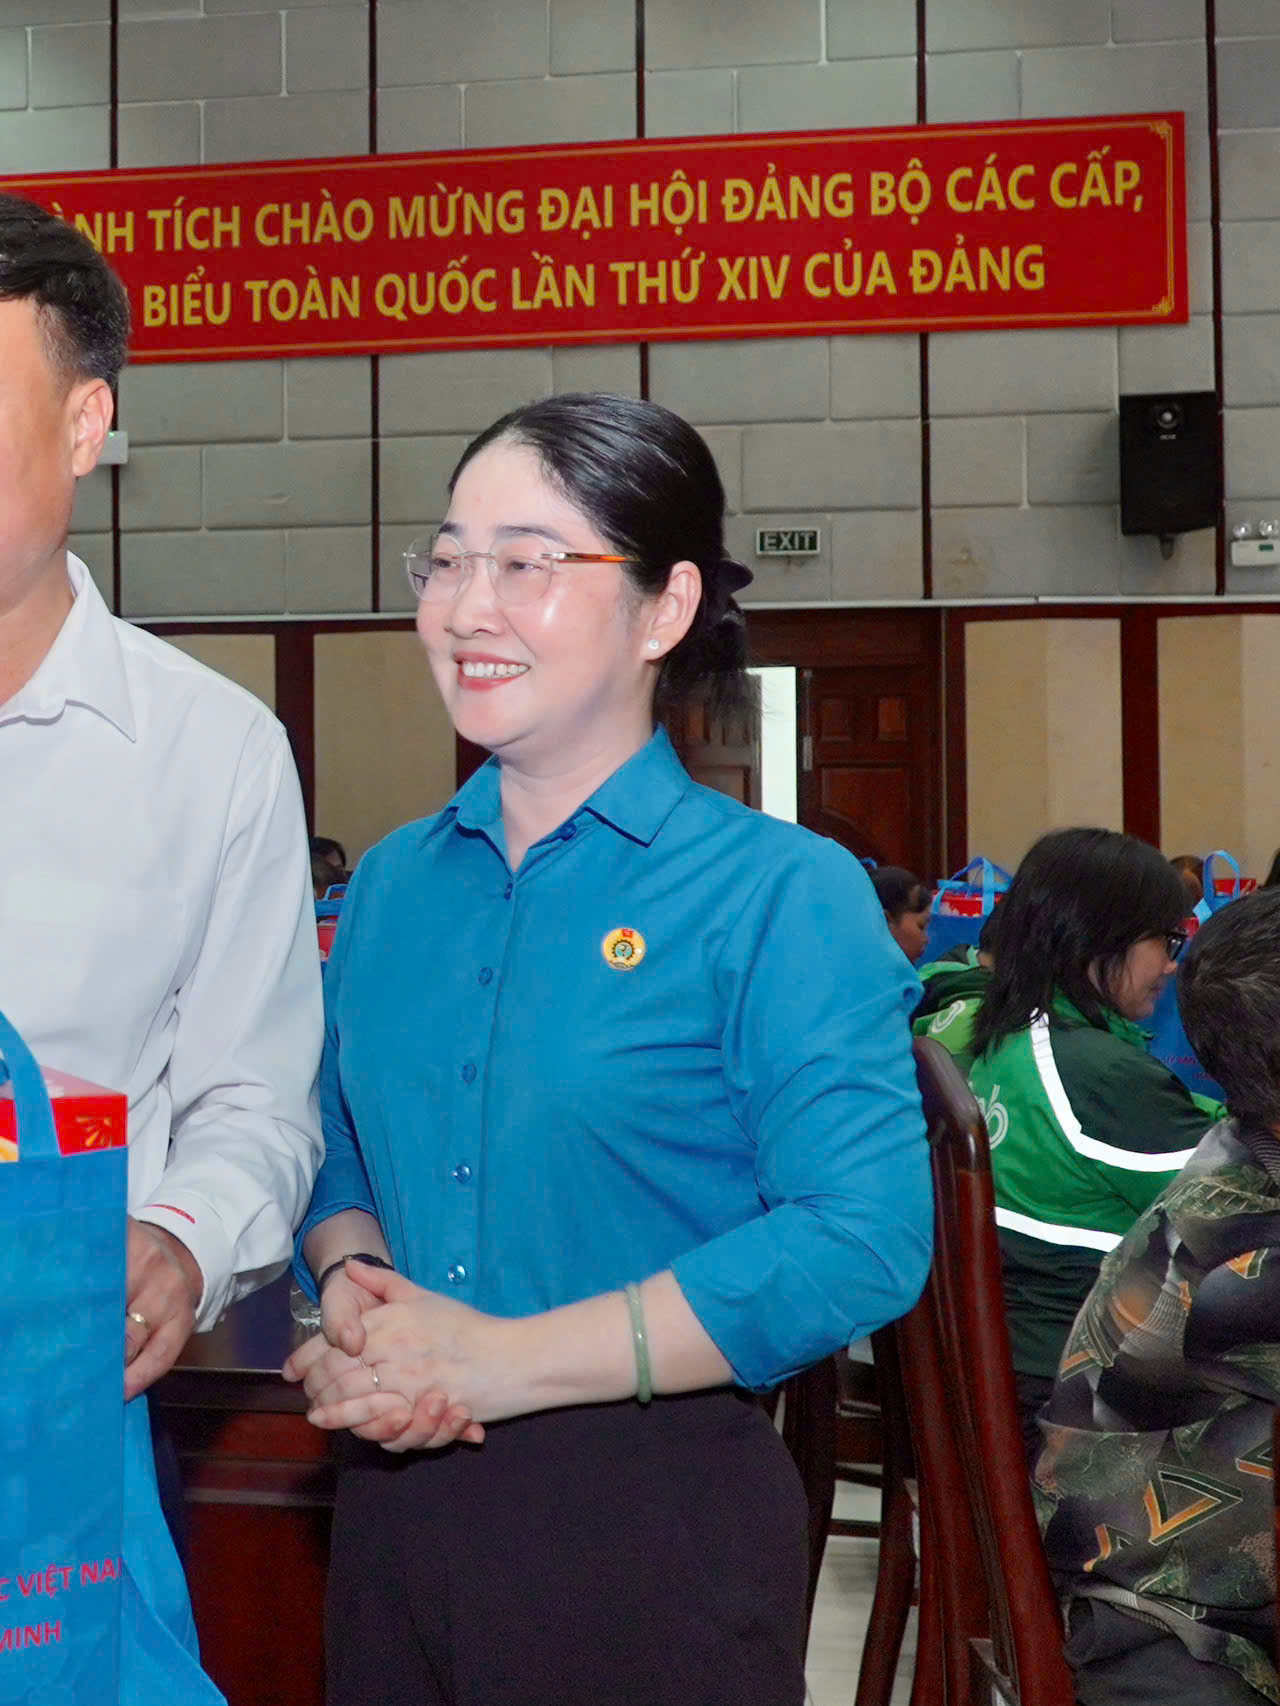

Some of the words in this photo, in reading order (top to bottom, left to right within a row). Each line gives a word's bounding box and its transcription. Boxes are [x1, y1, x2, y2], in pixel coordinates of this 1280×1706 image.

[146, 196, 242, 252] TÍCH
[254, 188, 375, 247] CHÀO
[388, 182, 526, 240] MỪNG
[537, 185, 614, 242] ĐẠI
[630, 168, 708, 237] HỘI
[720, 162, 855, 224] ĐẢNG
[870, 157, 933, 226] BỘ
[945, 152, 1036, 214] CÁC
[1049, 146, 1145, 212] CẤP,
[142, 265, 232, 327] BIỂU
[245, 265, 361, 323] TOÀN
[374, 255, 498, 321] QUỐC
[511, 251, 596, 312] LẦN
[609, 246, 705, 306] THỨ
[717, 254, 791, 302] XIV
[803, 238, 897, 299] CỦA
[908, 234, 1046, 295] ĐẢNG
[763, 531, 815, 550] EXIT
[17, 1563, 72, 1599] VIỆT
[80, 1556, 124, 1585] NA
